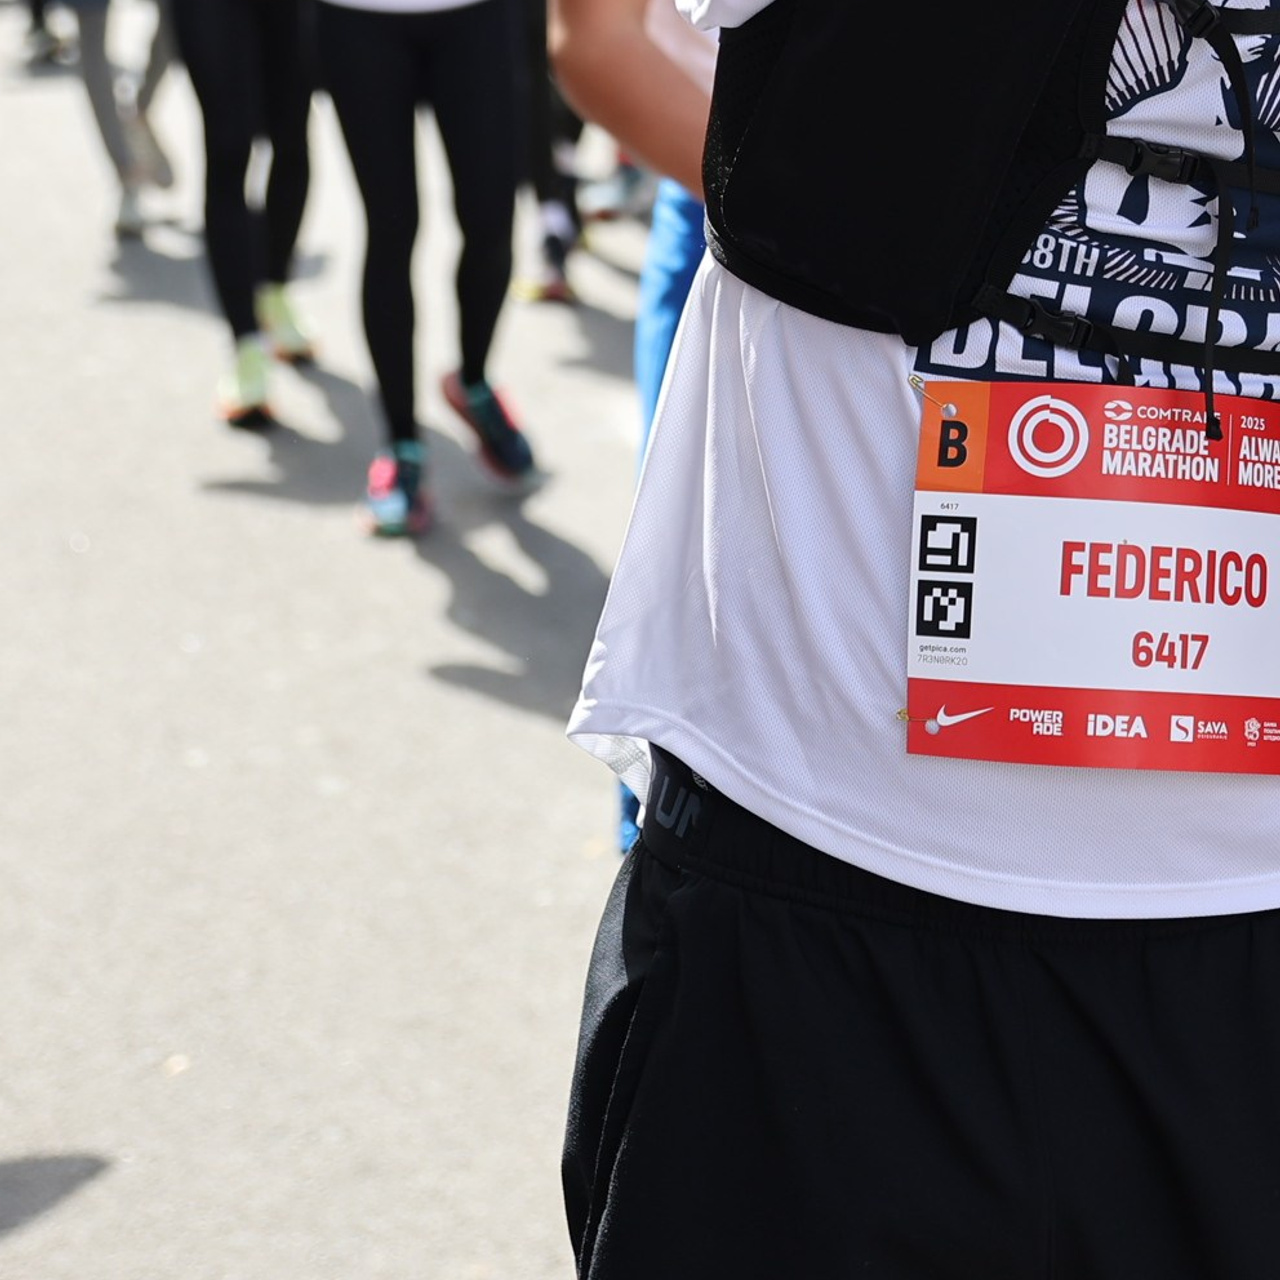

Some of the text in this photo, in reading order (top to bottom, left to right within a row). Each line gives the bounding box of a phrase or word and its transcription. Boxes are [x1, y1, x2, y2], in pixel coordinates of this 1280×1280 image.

[1240, 415, 1266, 431] 2025
[937, 419, 969, 468] B
[1103, 423, 1210, 456] BELGRADE
[1101, 450, 1219, 483] MARATHON
[940, 503, 960, 511] 6417
[1059, 540, 1268, 608] FEDERICO
[919, 643, 967, 655] getpica.com
[1132, 630, 1209, 670] 6417
[1009, 708, 1063, 723] POWER
[1032, 722, 1063, 737] ADE
[1197, 720, 1229, 734] SAVA
